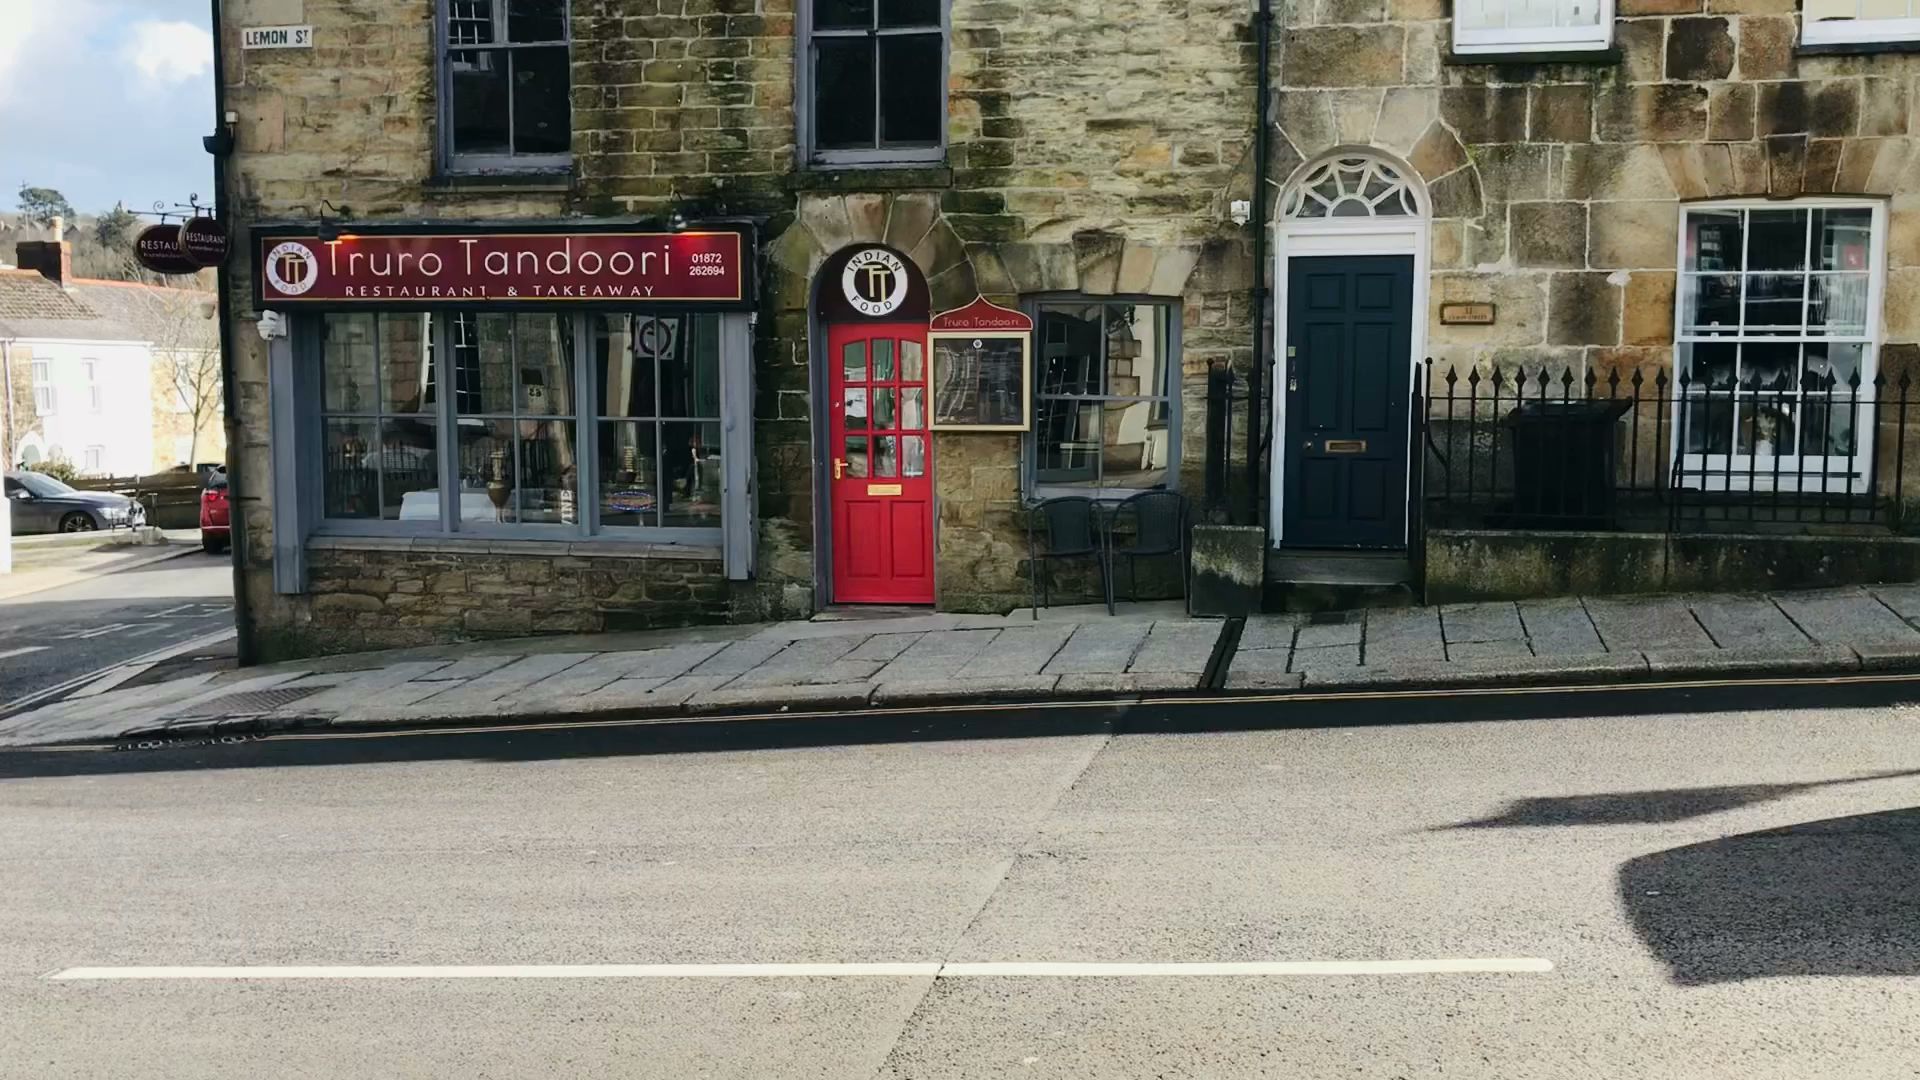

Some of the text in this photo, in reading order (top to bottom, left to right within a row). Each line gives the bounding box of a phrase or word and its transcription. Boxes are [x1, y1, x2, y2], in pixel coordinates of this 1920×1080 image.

[246, 30, 288, 45] LEMON
[140, 240, 179, 250] RESTAU
[324, 238, 670, 276] Truro Tandoori
[691, 253, 723, 263] 01872
[847, 251, 902, 272] INDIAN
[689, 266, 725, 276] 262694
[345, 285, 654, 297] RESTAURANT & TAKEAWAY
[852, 295, 892, 314] FOOD
[943, 316, 1019, 327] Truro Tandoori
